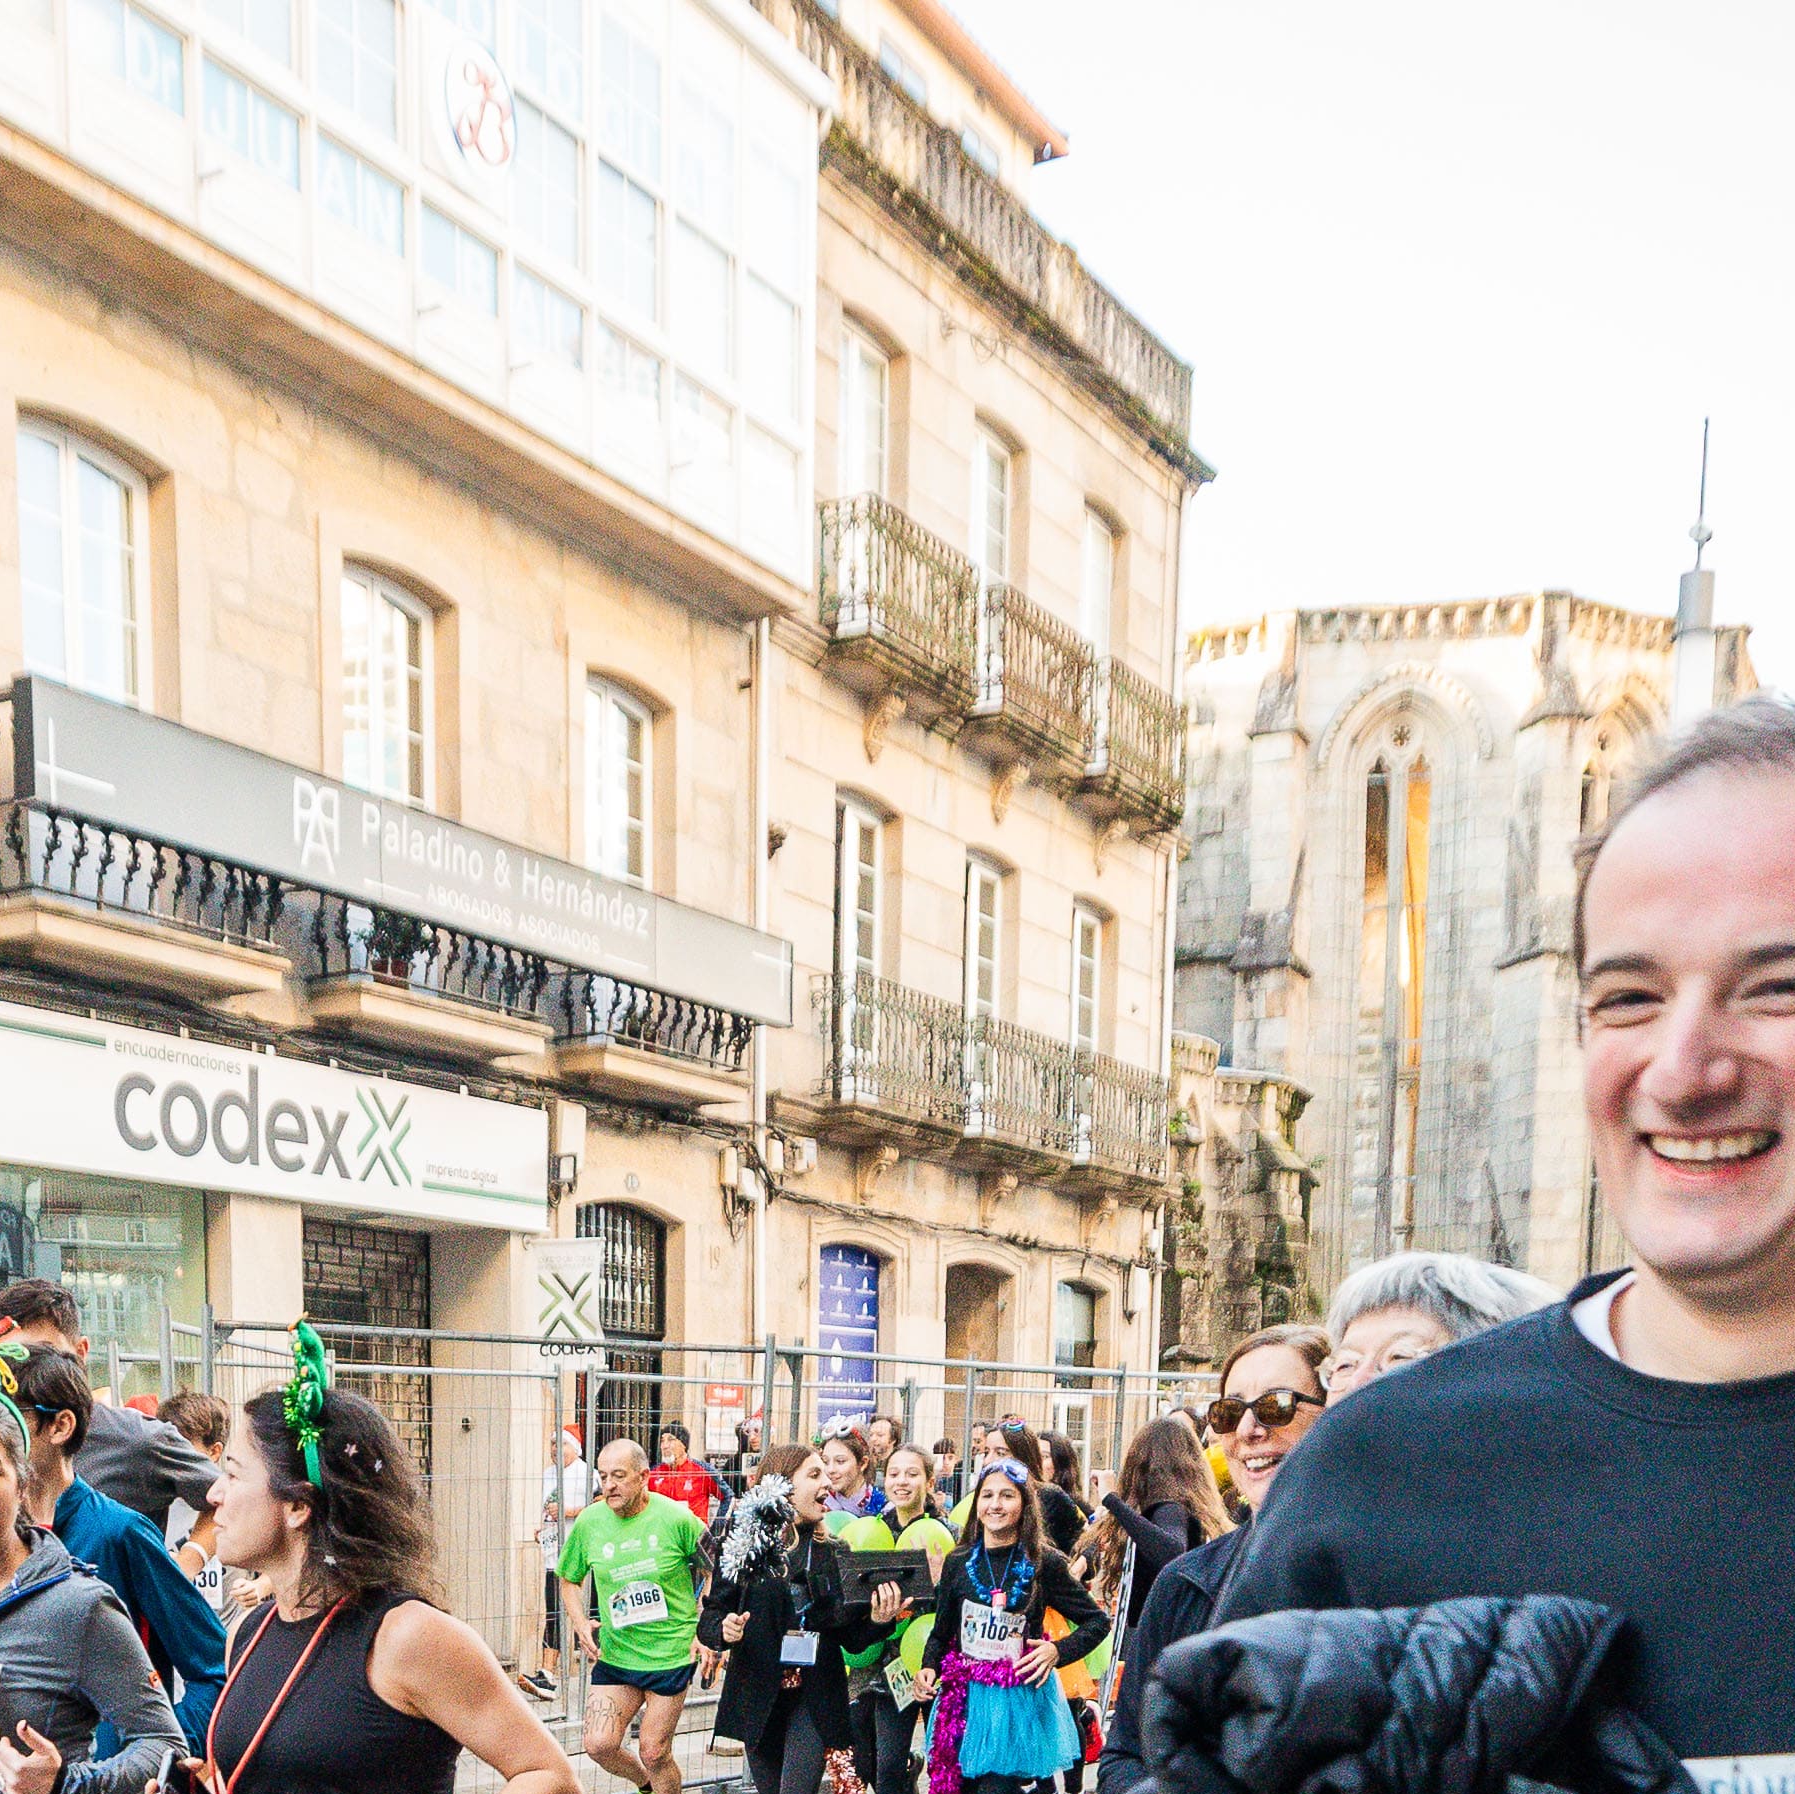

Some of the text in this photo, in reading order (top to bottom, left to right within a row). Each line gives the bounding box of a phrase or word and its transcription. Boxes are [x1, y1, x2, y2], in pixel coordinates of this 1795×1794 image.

[362, 802, 484, 878] Paladino
[492, 848, 512, 890] &
[522, 858, 650, 936] Hernández
[426, 883, 601, 955] ABOGADOS ASOCIADOS
[113, 1038, 242, 1076] encuadernaciones
[114, 1064, 351, 1180] codex
[425, 1160, 499, 1188] imprenta digital
[193, 1570, 218, 1588] 30
[629, 1588, 661, 1608] 1966
